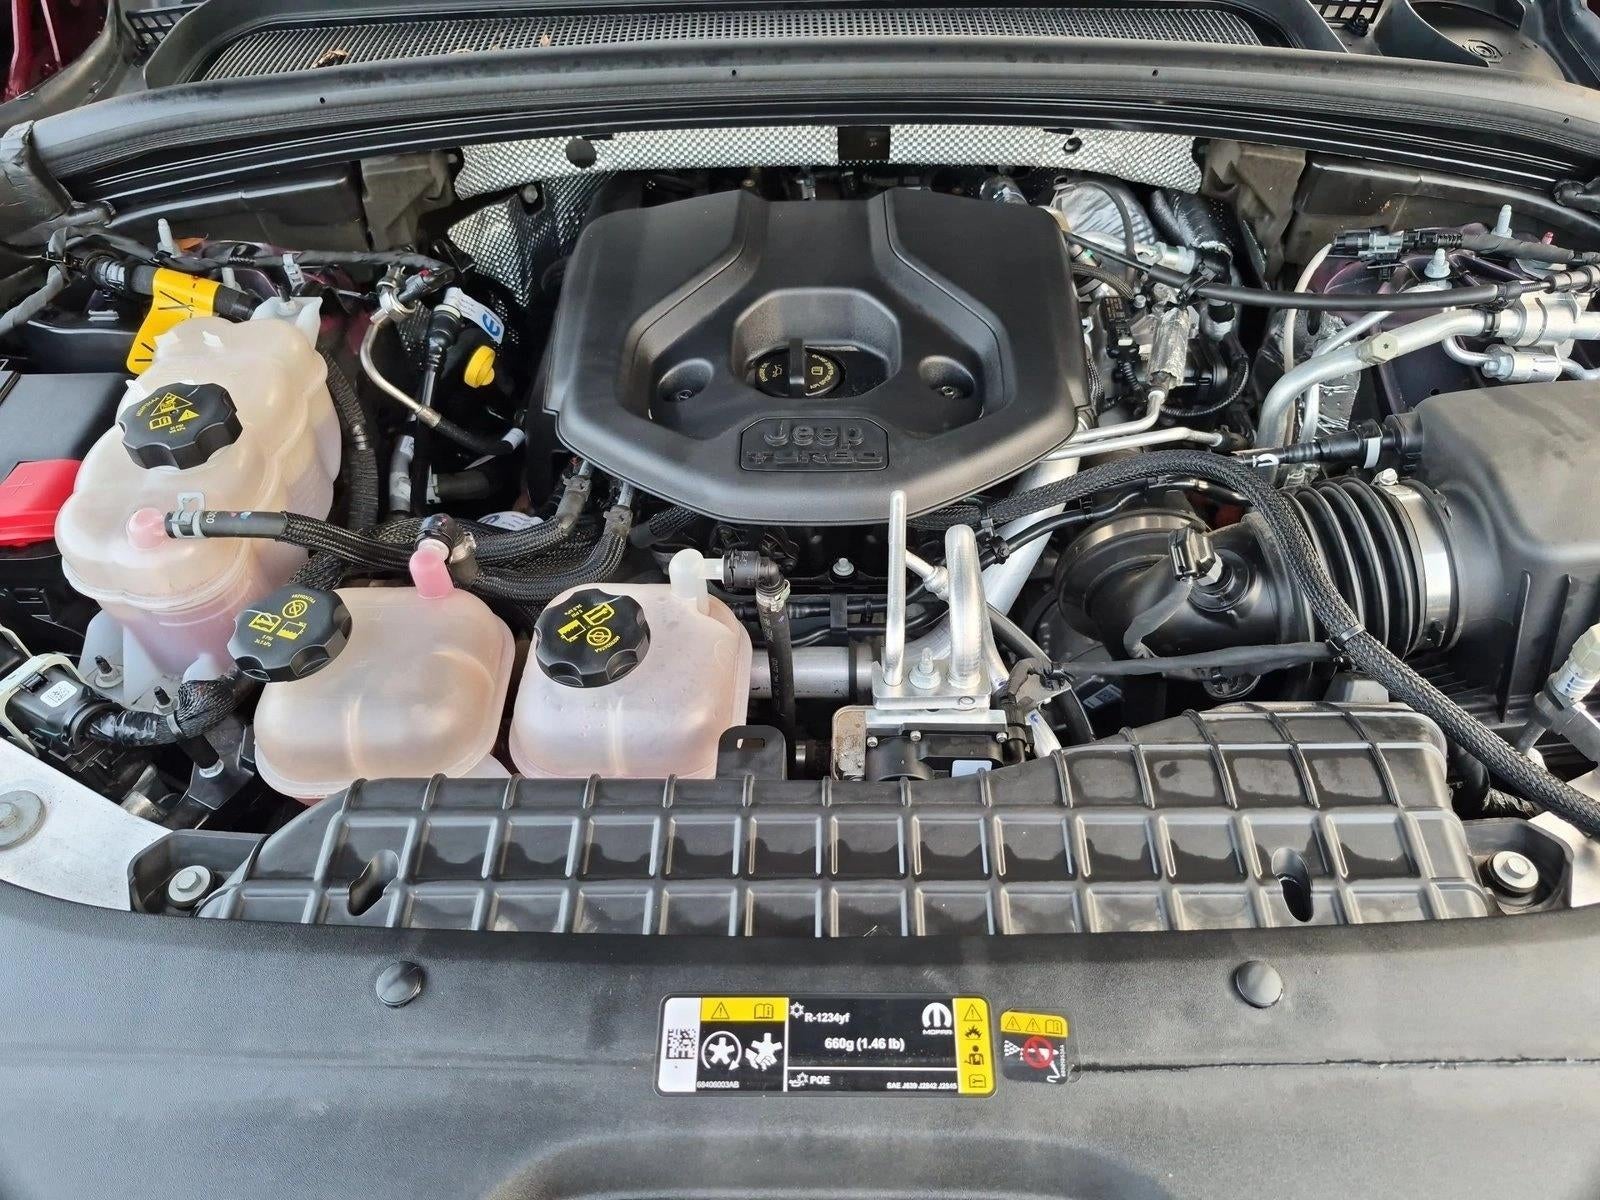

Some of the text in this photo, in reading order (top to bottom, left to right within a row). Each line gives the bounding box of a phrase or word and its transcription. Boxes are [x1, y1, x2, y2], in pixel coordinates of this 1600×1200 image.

[763, 420, 865, 450] Jeep
[804, 1012, 851, 1025] R-1234yf
[824, 1037, 905, 1052] 660g (1.46 lb)
[809, 1075, 831, 1085] POE
